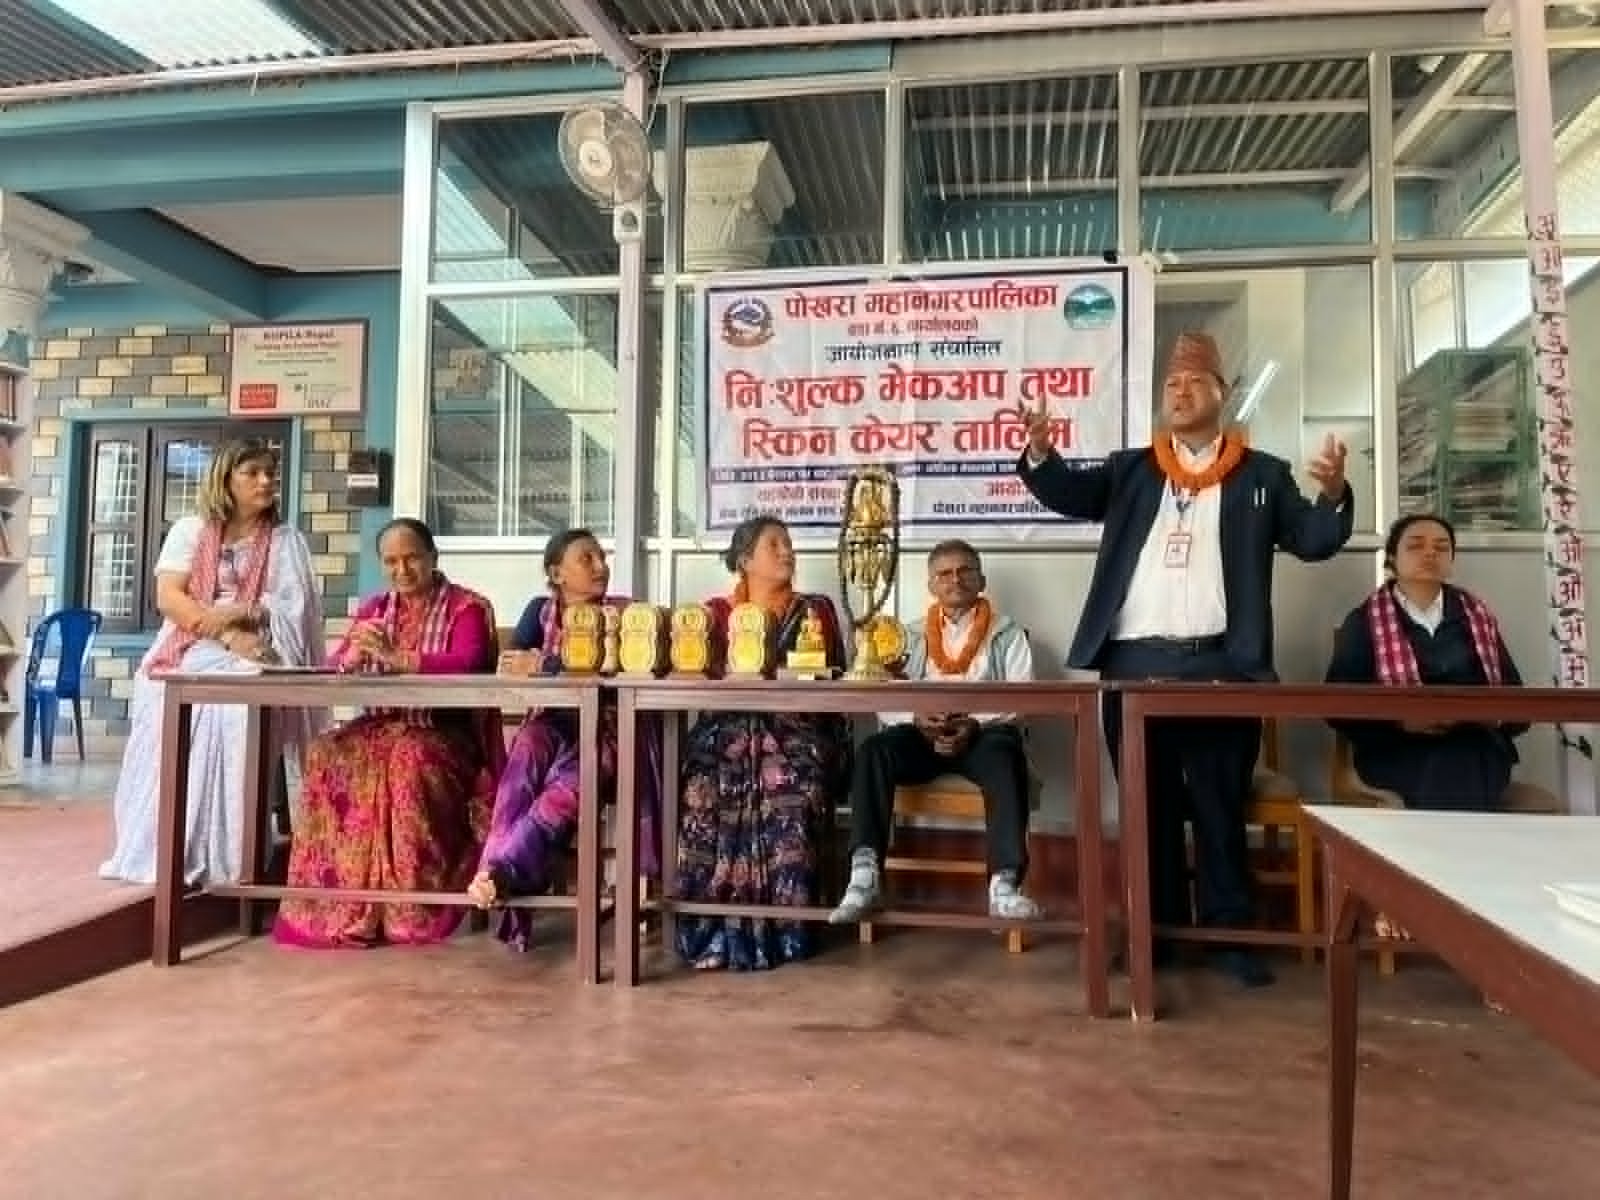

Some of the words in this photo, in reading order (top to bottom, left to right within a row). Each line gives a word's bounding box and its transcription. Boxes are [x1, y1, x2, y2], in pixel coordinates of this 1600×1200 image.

[785, 290, 856, 318] पोखरा
[865, 280, 1058, 313] महानगरपालिका
[879, 362, 1008, 402] मेकअप
[1020, 367, 1095, 401] तथा
[744, 417, 840, 460] स्किन
[848, 413, 942, 454] केयर
